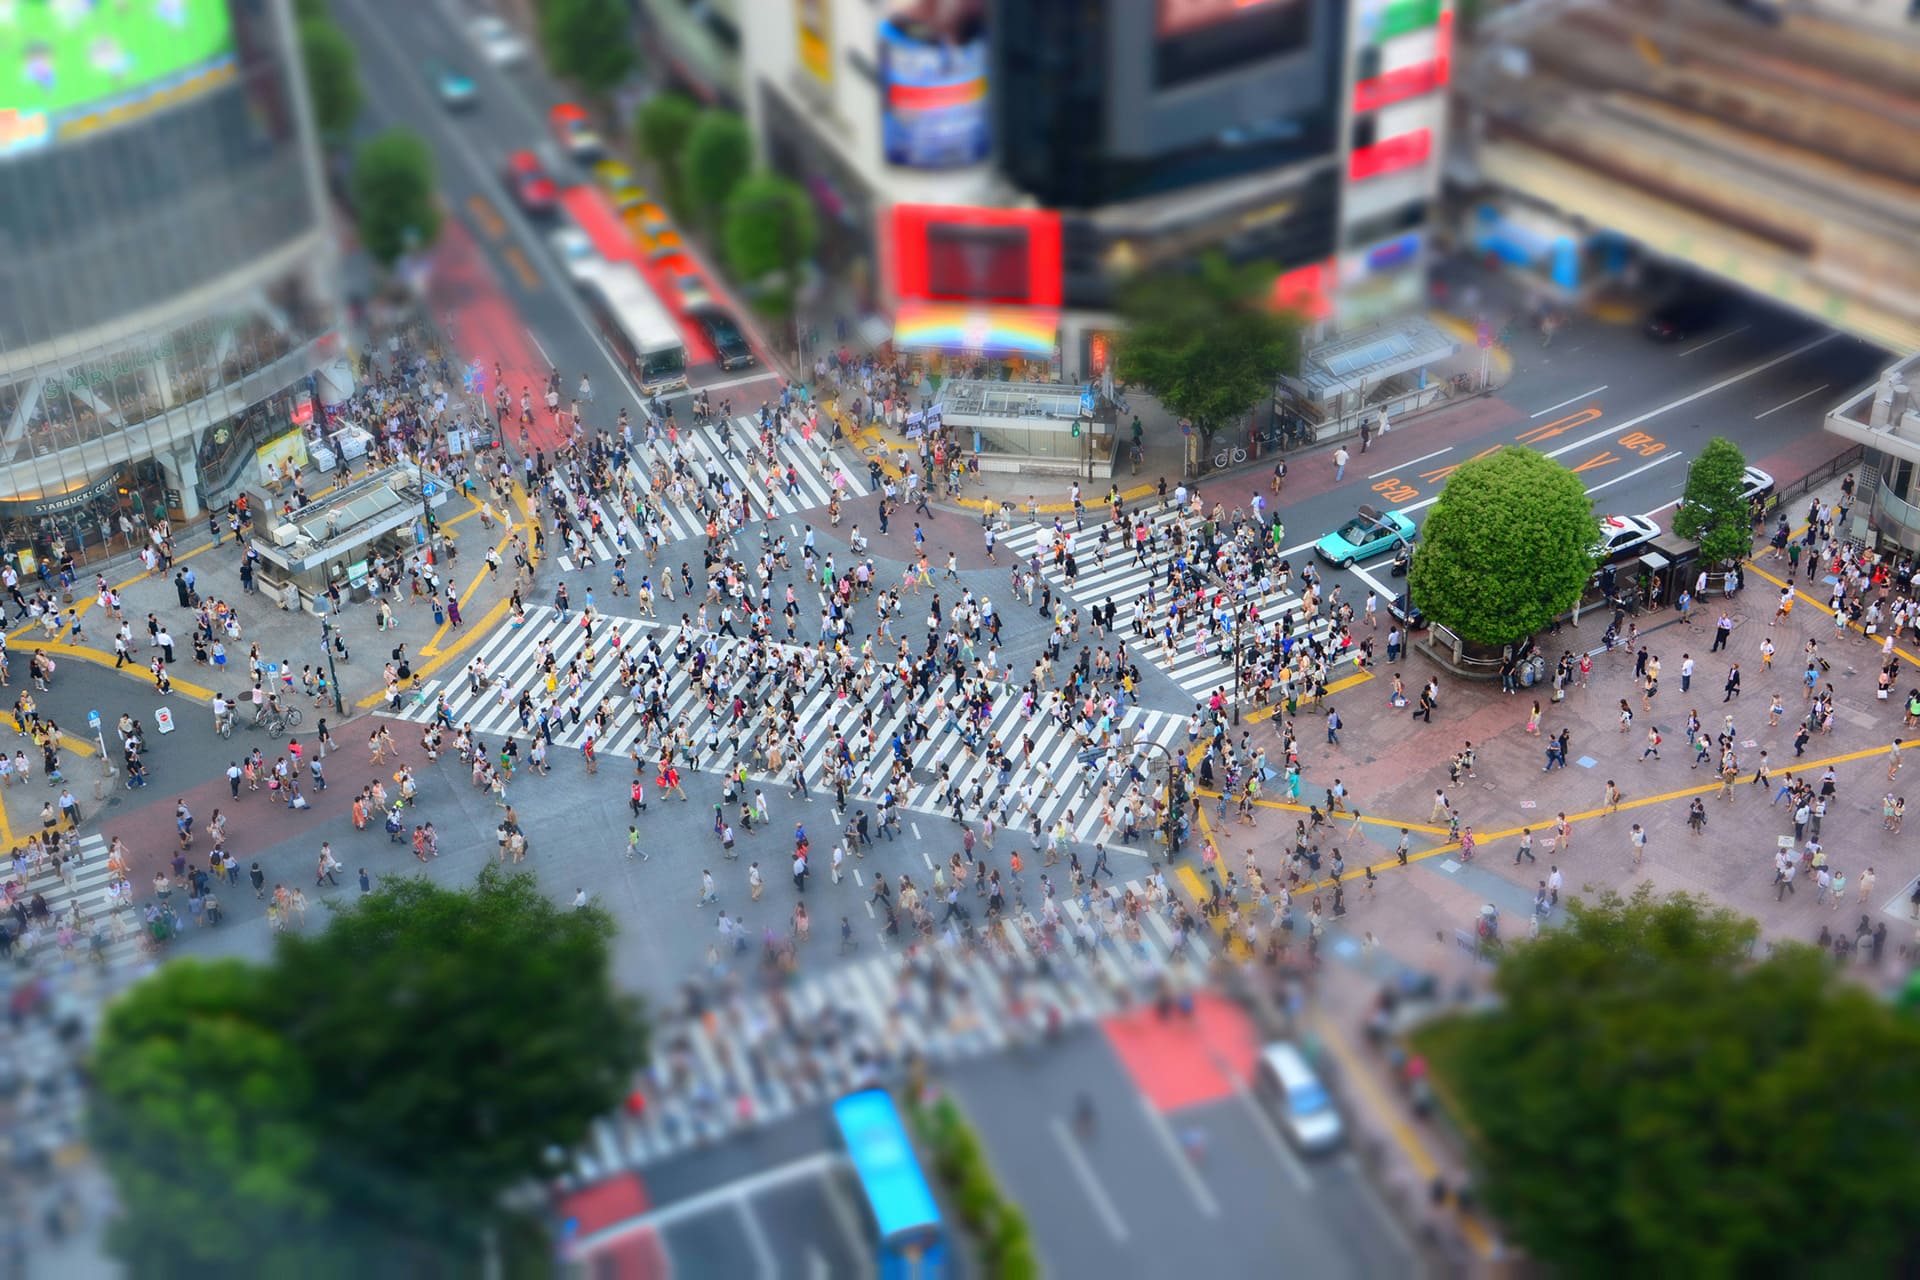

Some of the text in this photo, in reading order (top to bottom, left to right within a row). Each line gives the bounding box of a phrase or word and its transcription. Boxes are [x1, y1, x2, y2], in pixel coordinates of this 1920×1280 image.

[1617, 431, 1667, 457] 8-20
[35, 472, 120, 512] STARBUCKS COFFEE
[1371, 478, 1420, 504] 8-20
